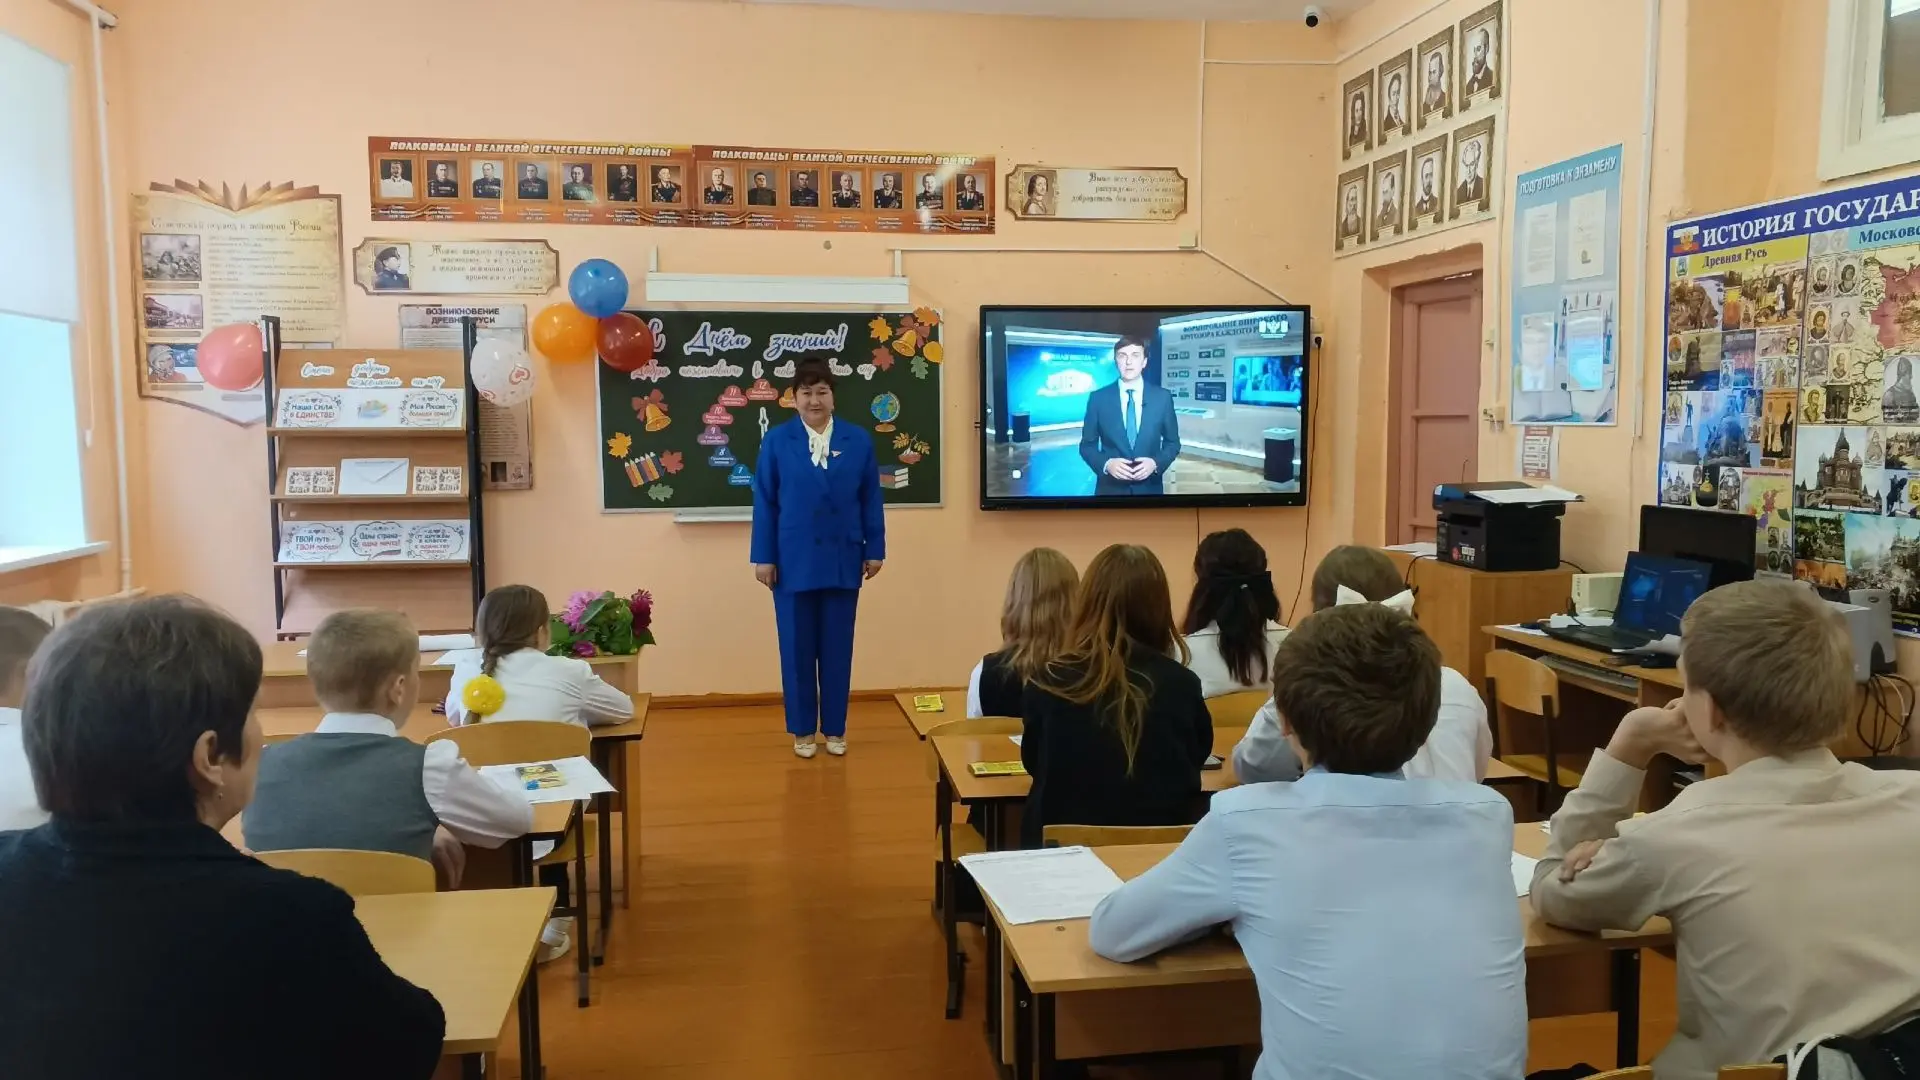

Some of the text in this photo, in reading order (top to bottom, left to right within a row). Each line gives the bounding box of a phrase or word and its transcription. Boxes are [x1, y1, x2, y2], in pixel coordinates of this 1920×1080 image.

[389, 141, 672, 156] ПОЛКОВОДЦЫ ВЕЛИКОЙ ОТЕЧЕСТВЕННОЙ ВОЙНЫ
[712, 149, 977, 166] ПОЛКОВОДЦЫ ВЕЛИКОЙ ОТЕЧЕСТВЕННОЙ ВОЙНЫ
[1520, 156, 1617, 195] ПОДГОТОВКА К ЭКЗАМЕНУ
[1702, 188, 1920, 248] ИСТОРИЯ ГОСУДАР
[1701, 247, 1768, 269] Древняя Русь
[425, 307, 500, 315] ВОЗНИКНОВЕНИЕ
[685, 322, 748, 352] Днём
[765, 324, 847, 359] знаний!
